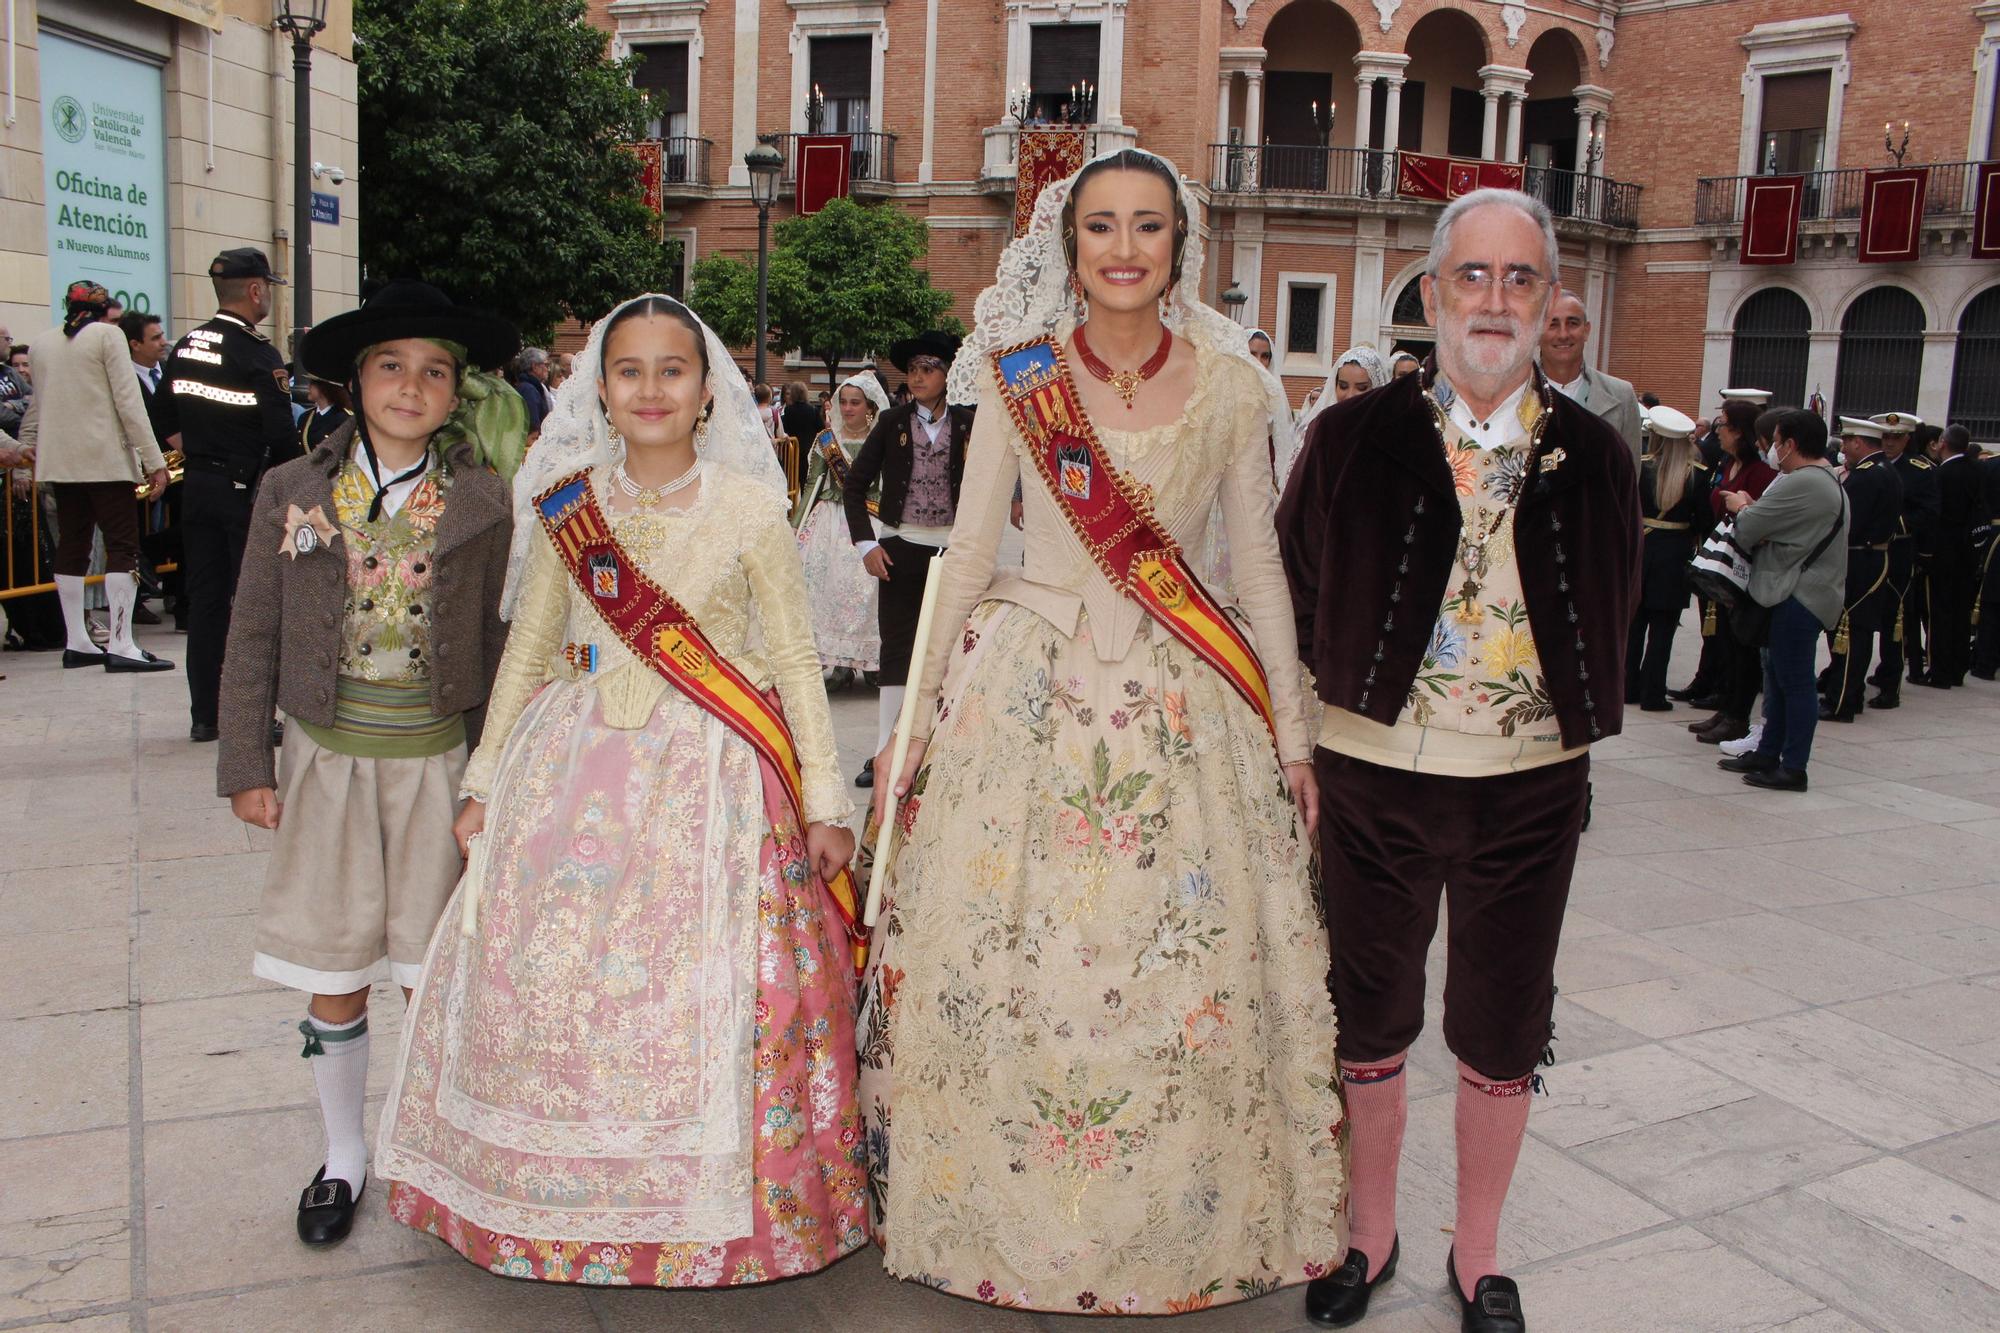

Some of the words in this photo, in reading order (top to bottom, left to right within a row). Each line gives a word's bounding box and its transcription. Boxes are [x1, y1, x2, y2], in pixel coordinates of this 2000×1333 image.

[92, 102, 145, 125] Universidad
[93, 117, 129, 135] Católica
[130, 125, 142, 137] de
[93, 129, 132, 147] Valencia
[56, 170, 123, 202] Oficina
[127, 183, 148, 206] de
[58, 204, 148, 239] Atención
[57, 240, 64, 249] a
[66, 238, 104, 255] Nuevos
[106, 245, 150, 261] Alumnos
[1095, 516, 1142, 553] 2020-2021
[624, 597, 666, 641] 2020-2021
[1493, 1085, 1522, 1096] Visca
